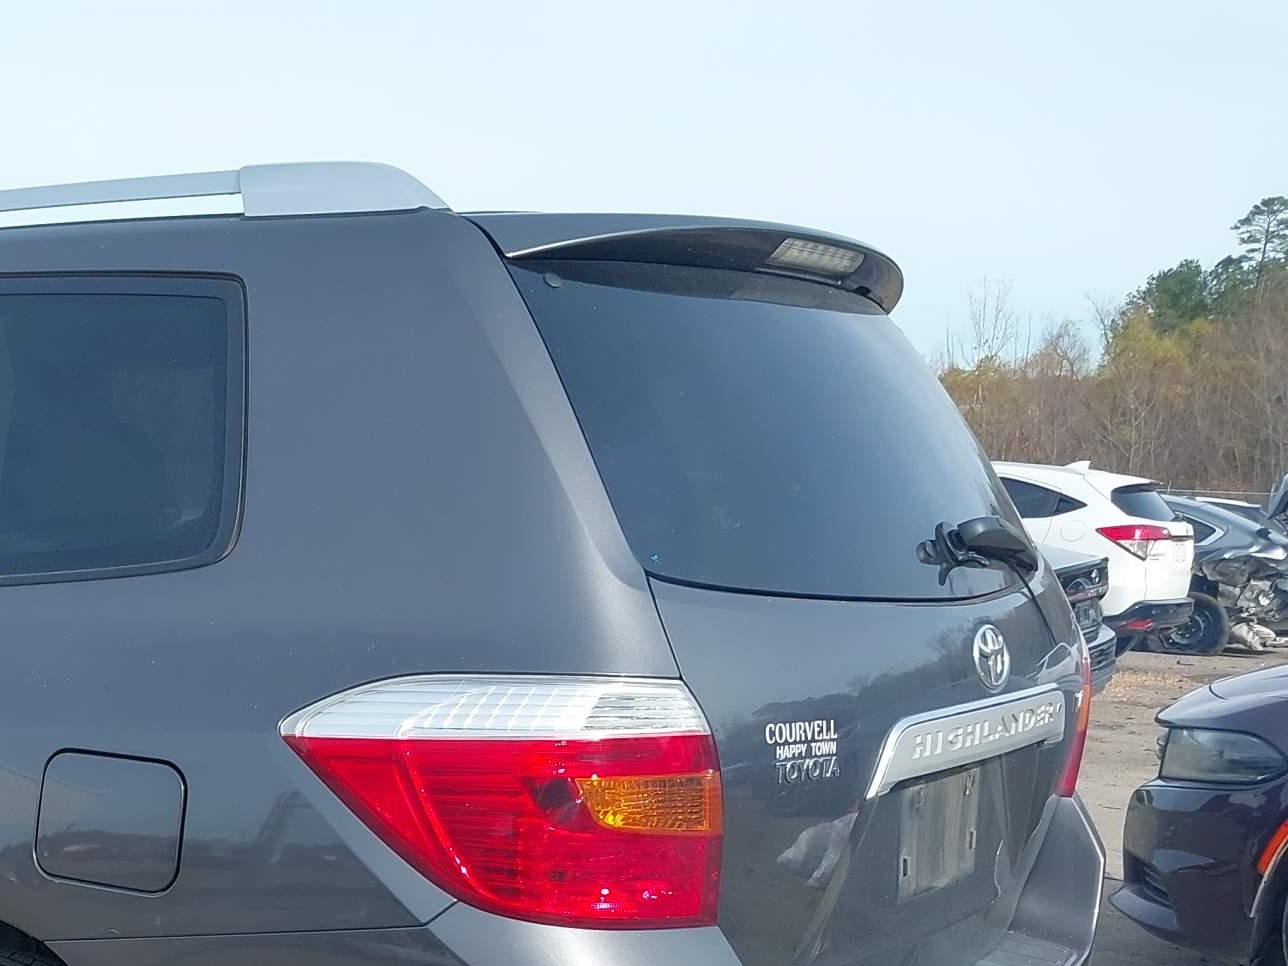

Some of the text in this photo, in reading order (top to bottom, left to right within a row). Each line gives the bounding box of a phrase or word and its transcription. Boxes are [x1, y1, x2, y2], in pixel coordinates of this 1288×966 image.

[765, 719, 838, 745] COURVELL
[911, 703, 1055, 760] HIGHLANDER
[776, 741, 837, 760] HAPPY TOWN
[776, 756, 840, 784] TOYOTA
